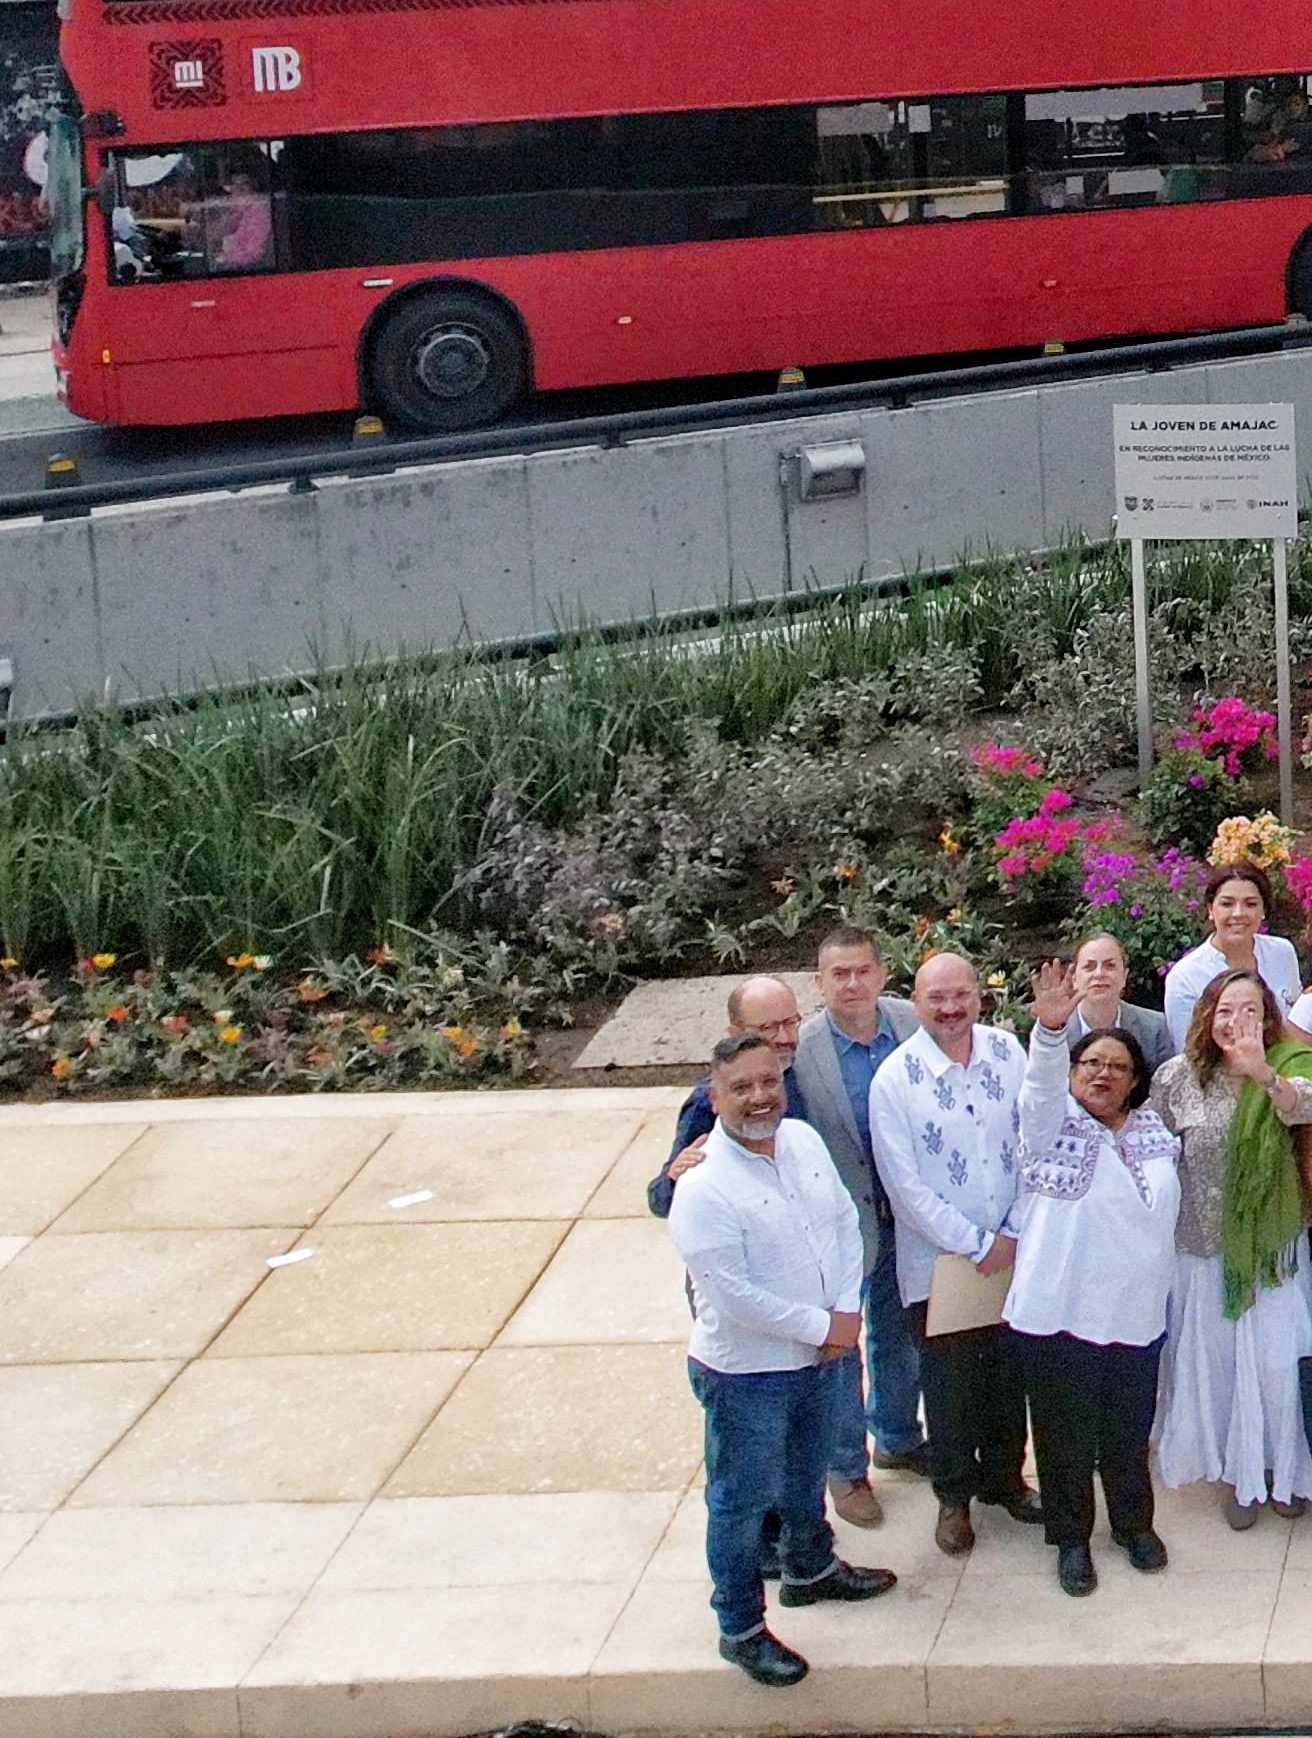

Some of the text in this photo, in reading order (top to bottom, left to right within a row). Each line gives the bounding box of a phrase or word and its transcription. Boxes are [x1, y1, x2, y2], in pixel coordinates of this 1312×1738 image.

[252, 46, 302, 92] MB
[1130, 419, 1279, 431] LA JOVEN DE AMAJAC
[1119, 443, 1290, 453] EN RECONOCIMIENTO A LA LUCHA DE LAS
[1137, 454, 1175, 462] MUJERES
[1223, 454, 1236, 462] DE
[1258, 500, 1289, 508] INAH
